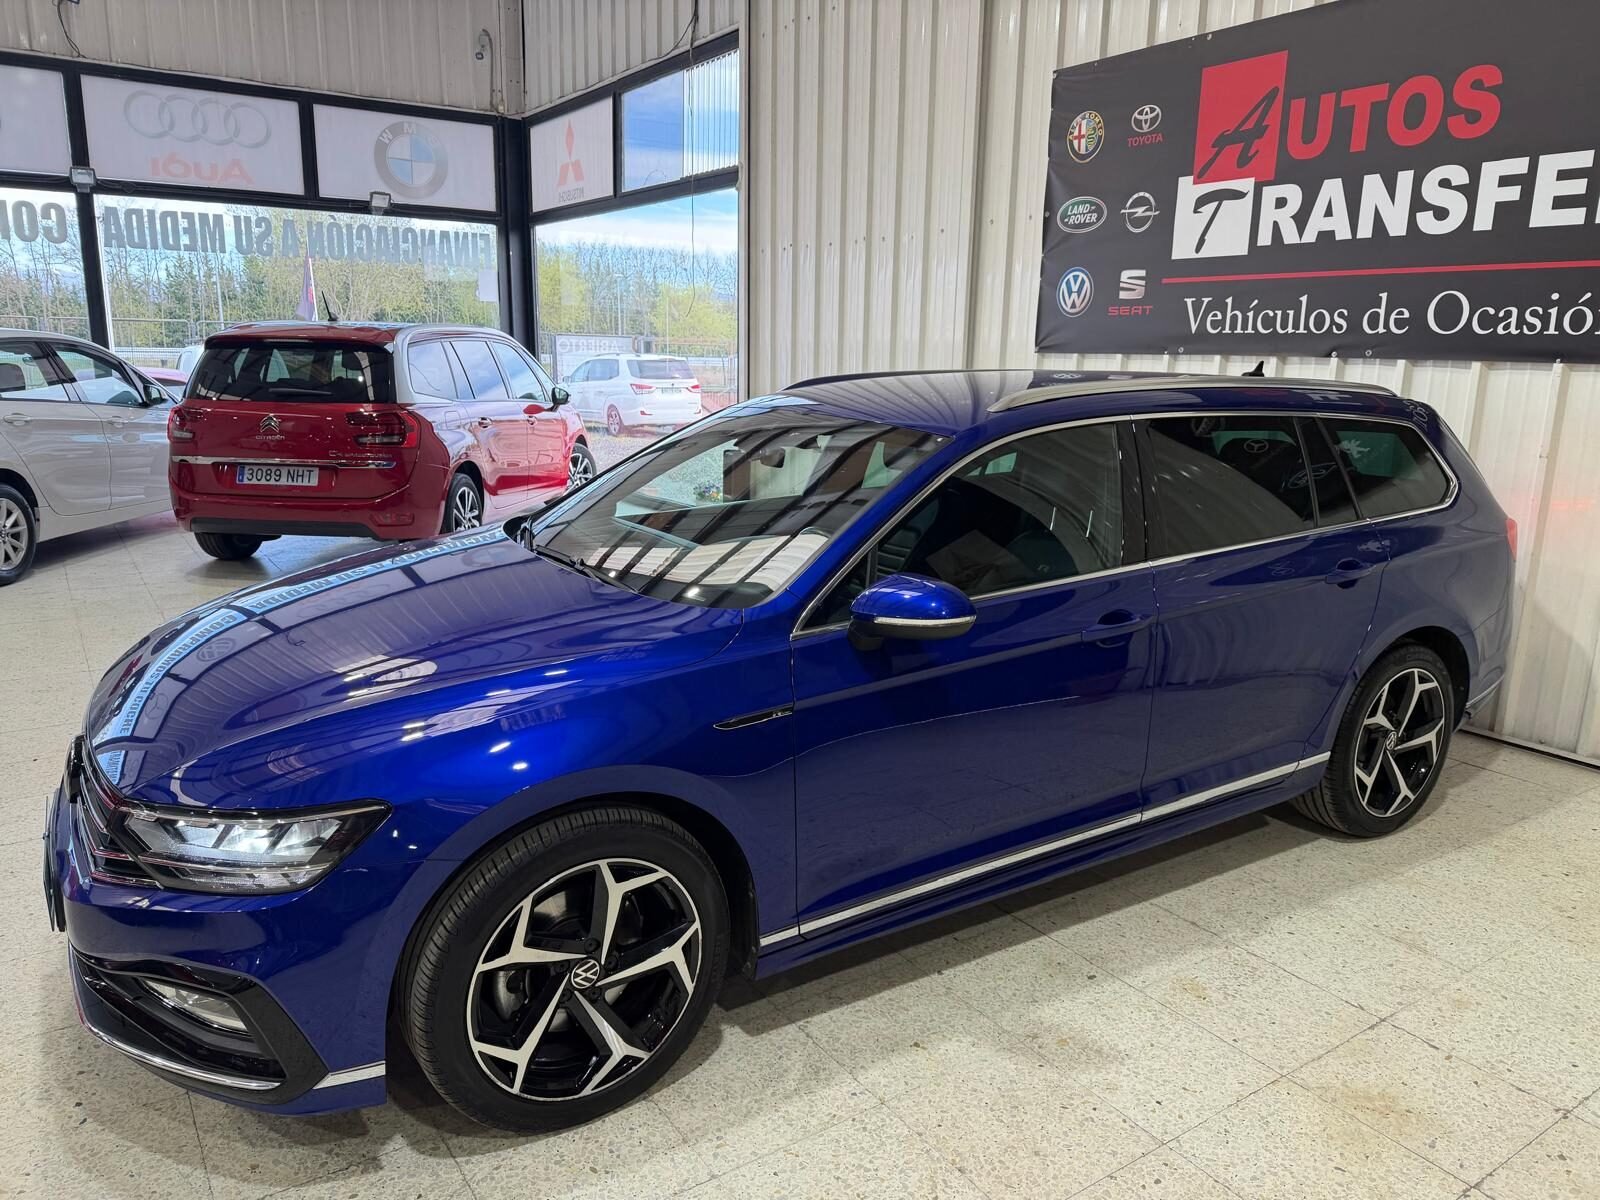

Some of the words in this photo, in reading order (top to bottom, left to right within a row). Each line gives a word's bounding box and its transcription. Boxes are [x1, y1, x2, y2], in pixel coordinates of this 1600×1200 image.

[1196, 64, 1504, 180] AUTOS
[1127, 133, 1164, 148] TOYOTA
[1067, 203, 1091, 216] LAND
[1193, 149, 1600, 254] TRANSFE
[1067, 212, 1098, 225] ROVER
[1107, 305, 1153, 316] SEAT
[1184, 292, 1348, 335] Vehículos
[1362, 291, 1411, 335] de
[1427, 289, 1600, 336] Ocasió
[246, 467, 282, 482] 3089
[286, 468, 315, 484] NHT
